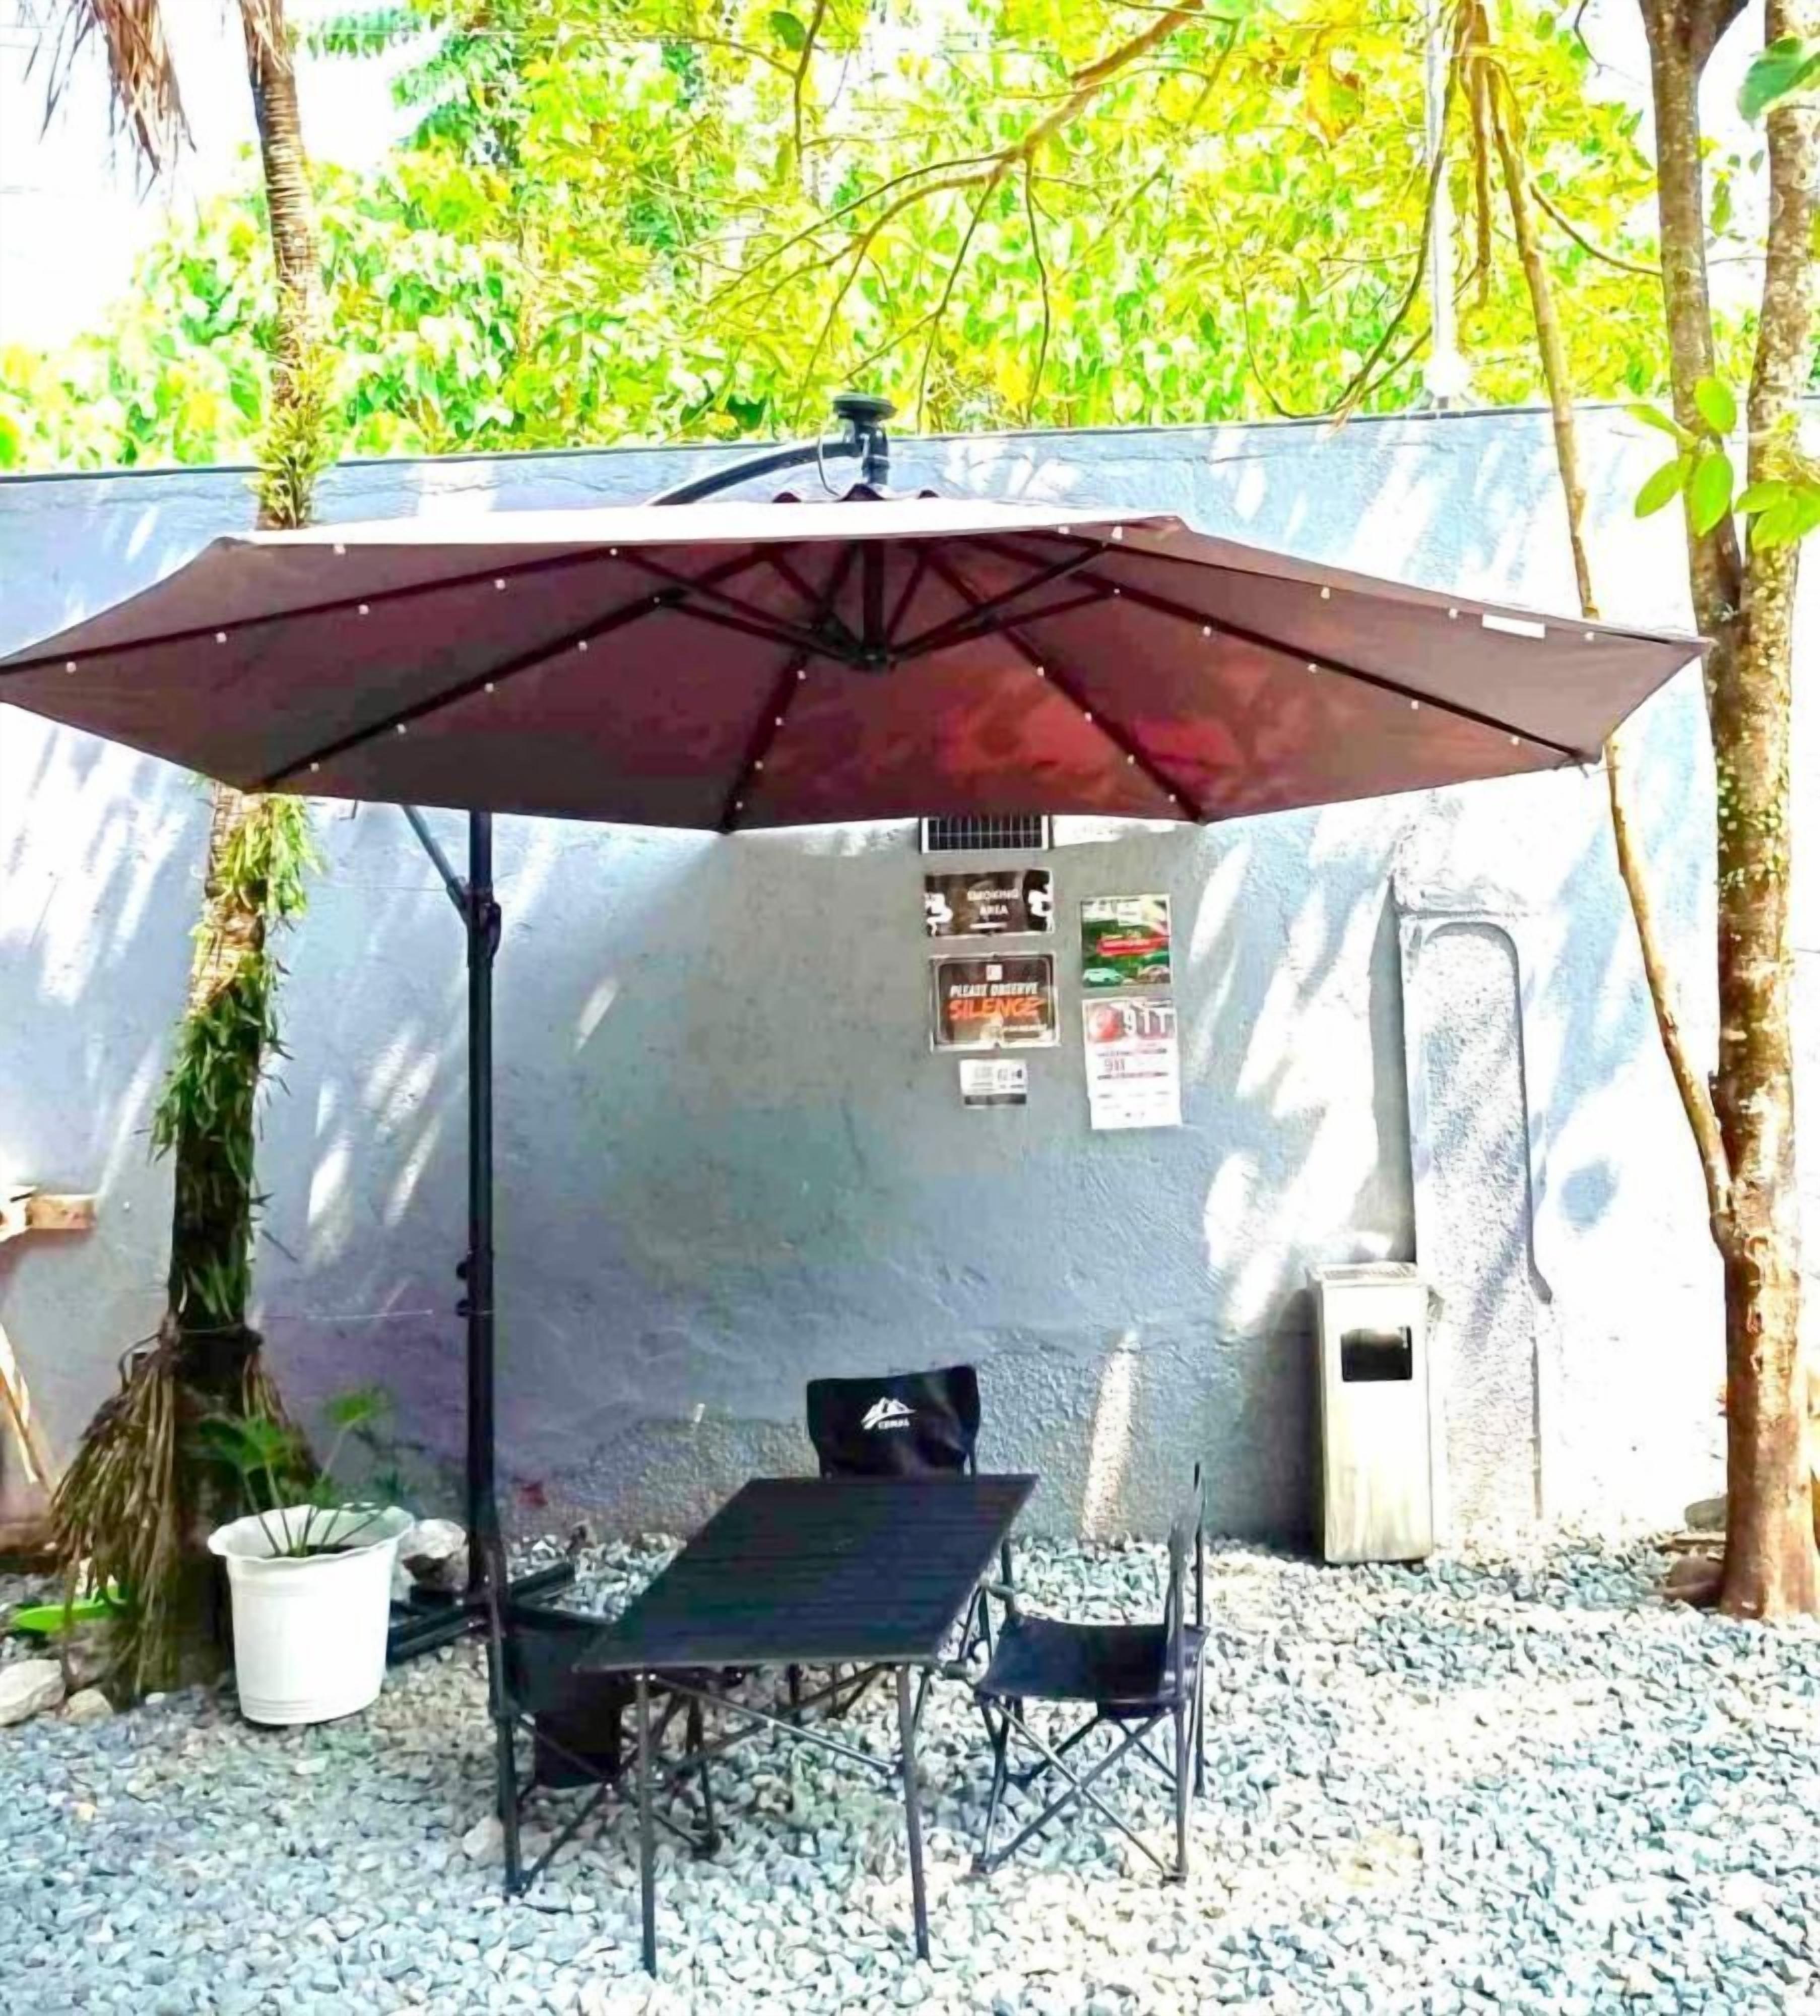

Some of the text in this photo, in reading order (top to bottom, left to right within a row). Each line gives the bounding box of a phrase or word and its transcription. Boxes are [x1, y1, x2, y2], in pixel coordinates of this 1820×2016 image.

[966, 889, 1019, 901] SMOKING
[980, 904, 1009, 916] AREA
[950, 982, 1038, 997] PLEASE OBSERVE
[948, 995, 1046, 1021] SILENCE
